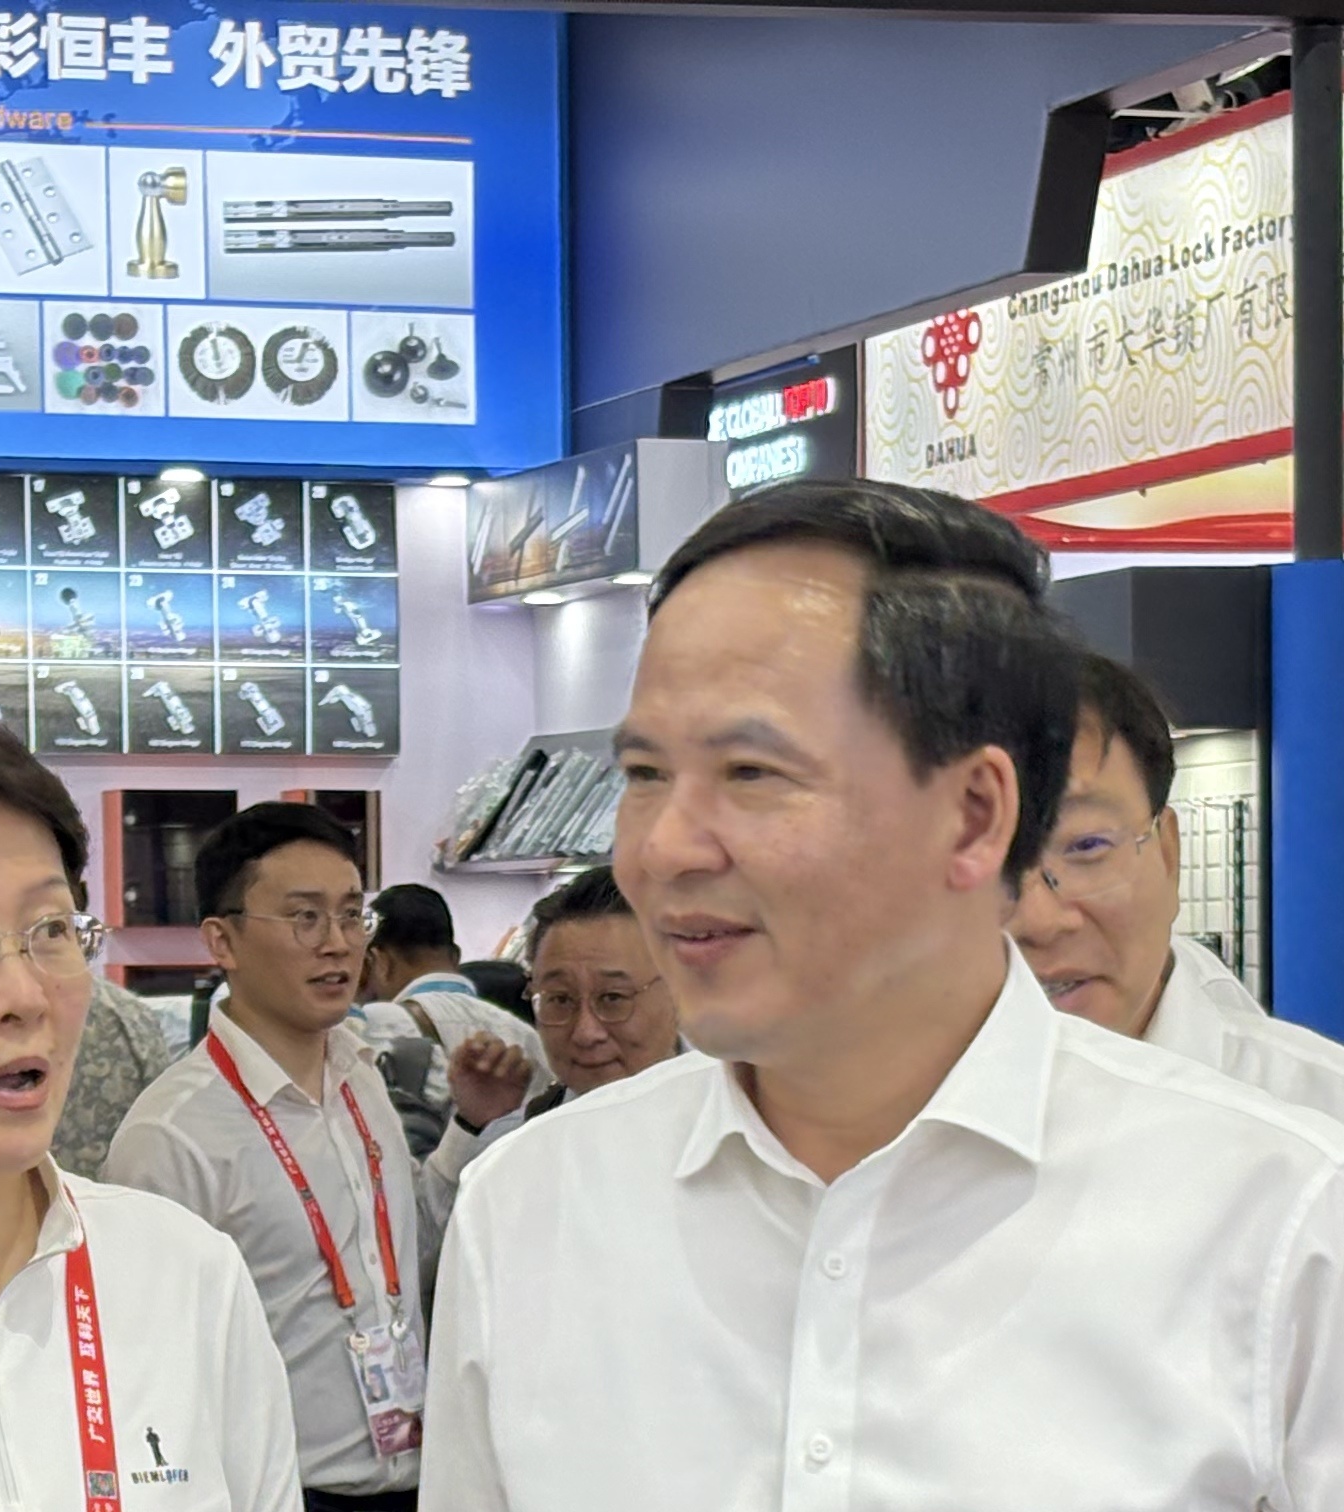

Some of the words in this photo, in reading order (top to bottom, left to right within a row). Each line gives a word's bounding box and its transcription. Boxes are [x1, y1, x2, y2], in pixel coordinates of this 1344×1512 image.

[211, 19, 474, 98] 外贸先锋
[1007, 278, 1102, 320] Changzhou
[1108, 254, 1164, 290] Dahua
[1170, 235, 1215, 273] Lock
[925, 433, 977, 470] DAHUA
